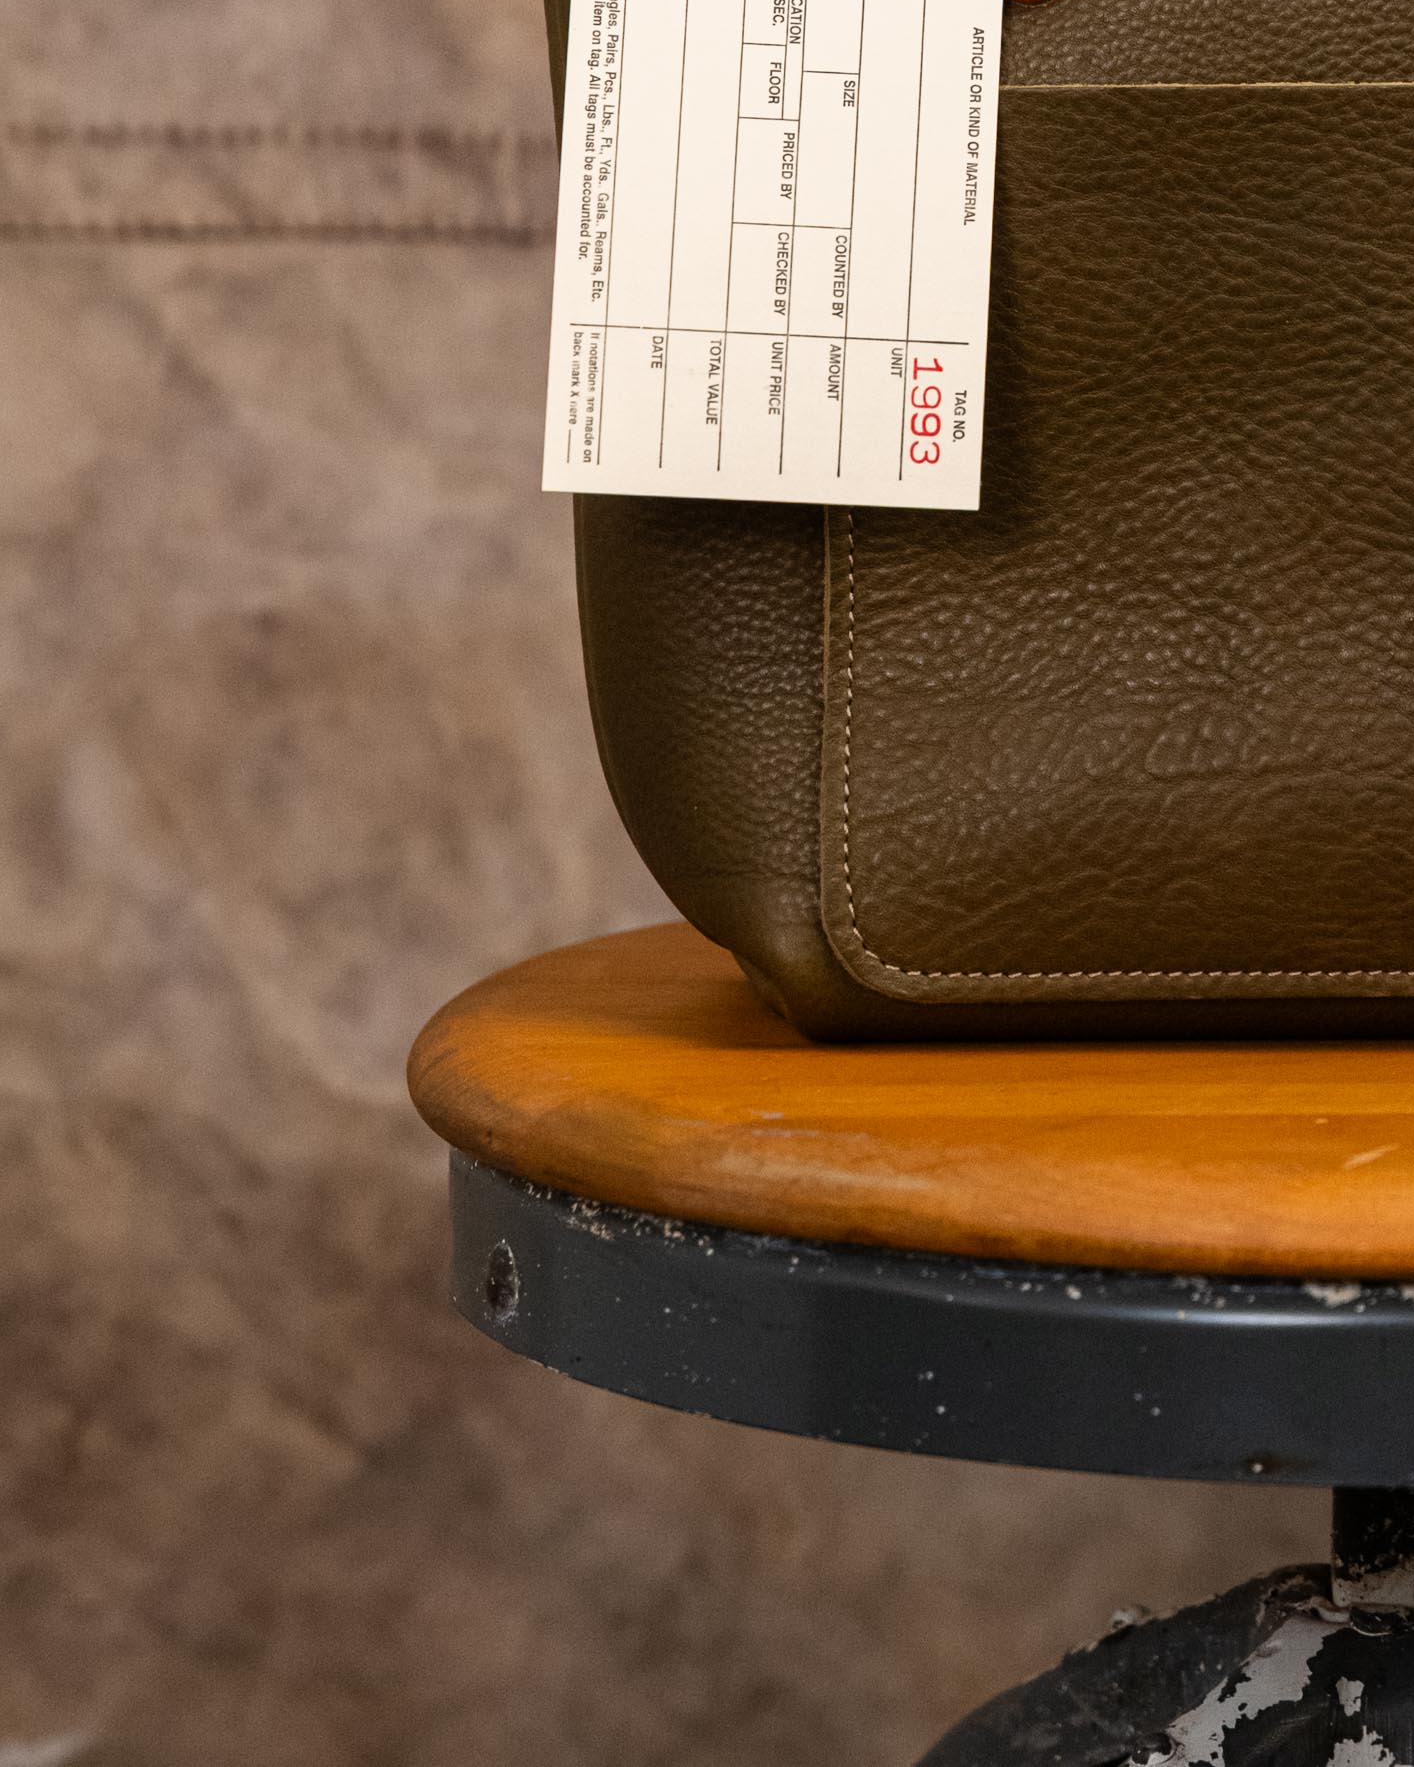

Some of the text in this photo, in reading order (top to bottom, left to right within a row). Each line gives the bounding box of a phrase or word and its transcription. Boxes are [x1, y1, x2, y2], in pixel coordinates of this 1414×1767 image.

[592, 0, 604, 26] item
[592, 30, 602, 45] on
[605, 34, 619, 67] Pairs,
[587, 49, 601, 70] tag.
[590, 74, 601, 90] All
[603, 71, 617, 100] Pcs.,
[768, 61, 782, 104] FLOOR
[843, 81, 856, 108] SIZE
[585, 93, 598, 120] tags
[600, 104, 615, 133] Lbs.,
[585, 123, 597, 153] must
[963, 27, 985, 225] ARTICLE OR KIND OF MATERIAL
[599, 137, 613, 155] Ft.,
[584, 157, 596, 171] be
[780, 132, 795, 200] PRICED BY
[579, 174, 593, 238] accounted
[578, 241, 589, 260] for.
[591, 231, 607, 275] Reams,
[774, 232, 790, 316] CHECKED BY
[832, 235, 848, 319] COUNTED BY
[592, 280, 605, 302] Etc.
[651, 335, 664, 369] DATE
[891, 347, 903, 378] UNIT
[706, 339, 721, 425] TOTAL VALUE
[768, 341, 784, 415] UNIT PRICE
[827, 344, 842, 401] AMOUNT
[909, 357, 943, 464] 1993
[952, 390, 967, 442] TAG NO.
[584, 416, 595, 446] made
[583, 449, 592, 463] on
